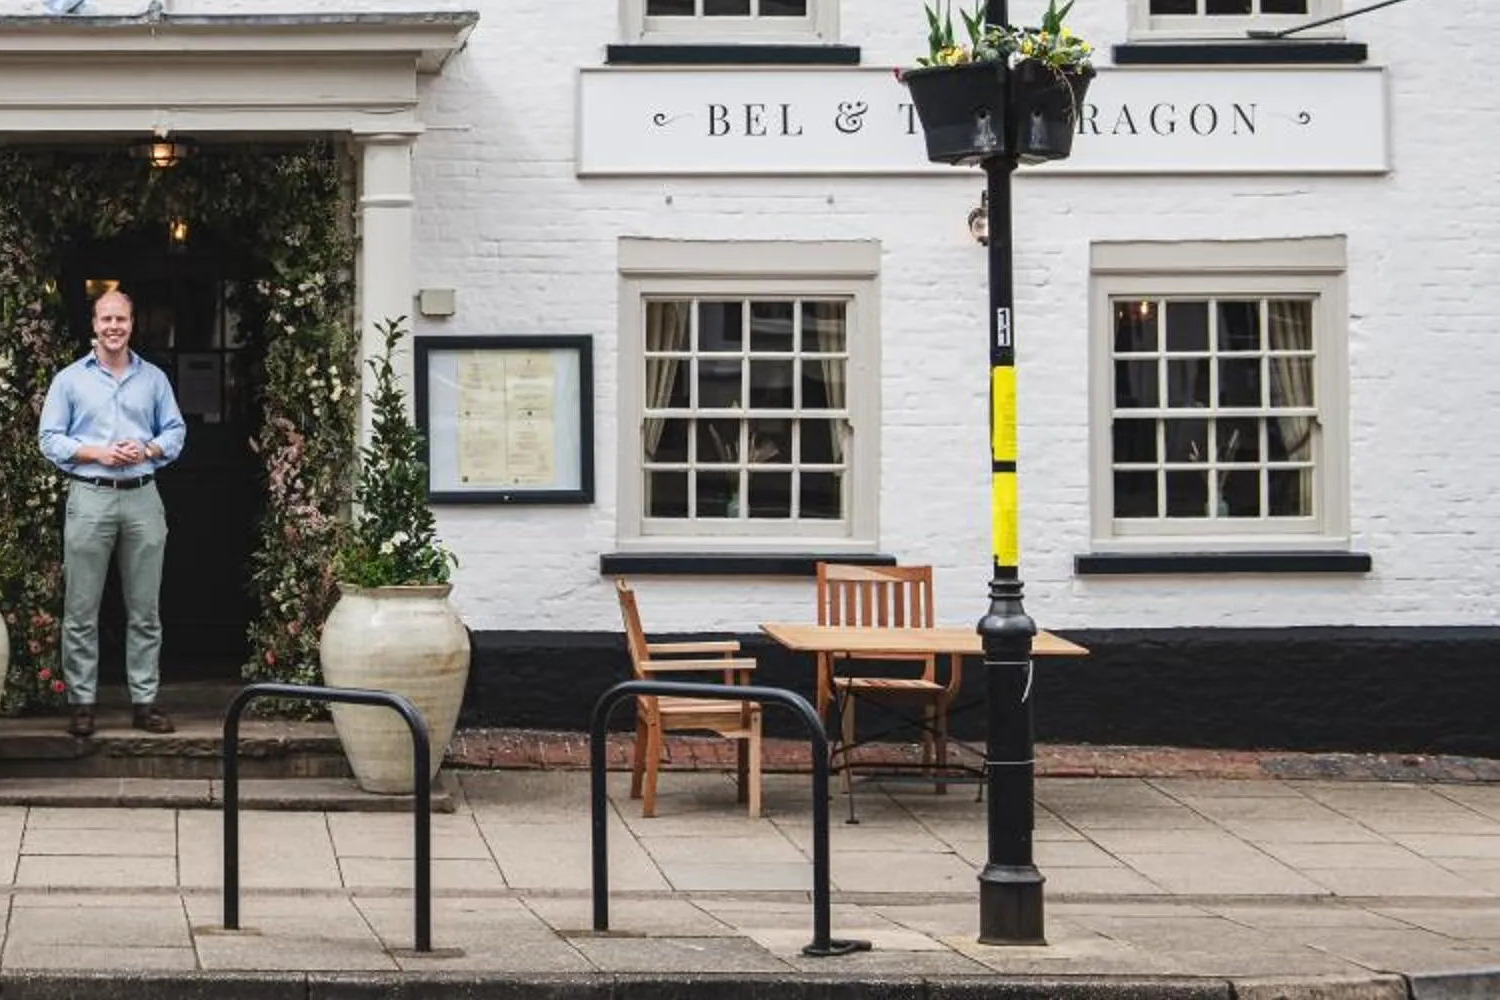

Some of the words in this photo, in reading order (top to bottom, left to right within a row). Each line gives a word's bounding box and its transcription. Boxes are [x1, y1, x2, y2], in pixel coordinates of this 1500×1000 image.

[708, 103, 805, 136] BEL
[834, 101, 870, 136] &
[1077, 102, 1257, 136] RAGON
